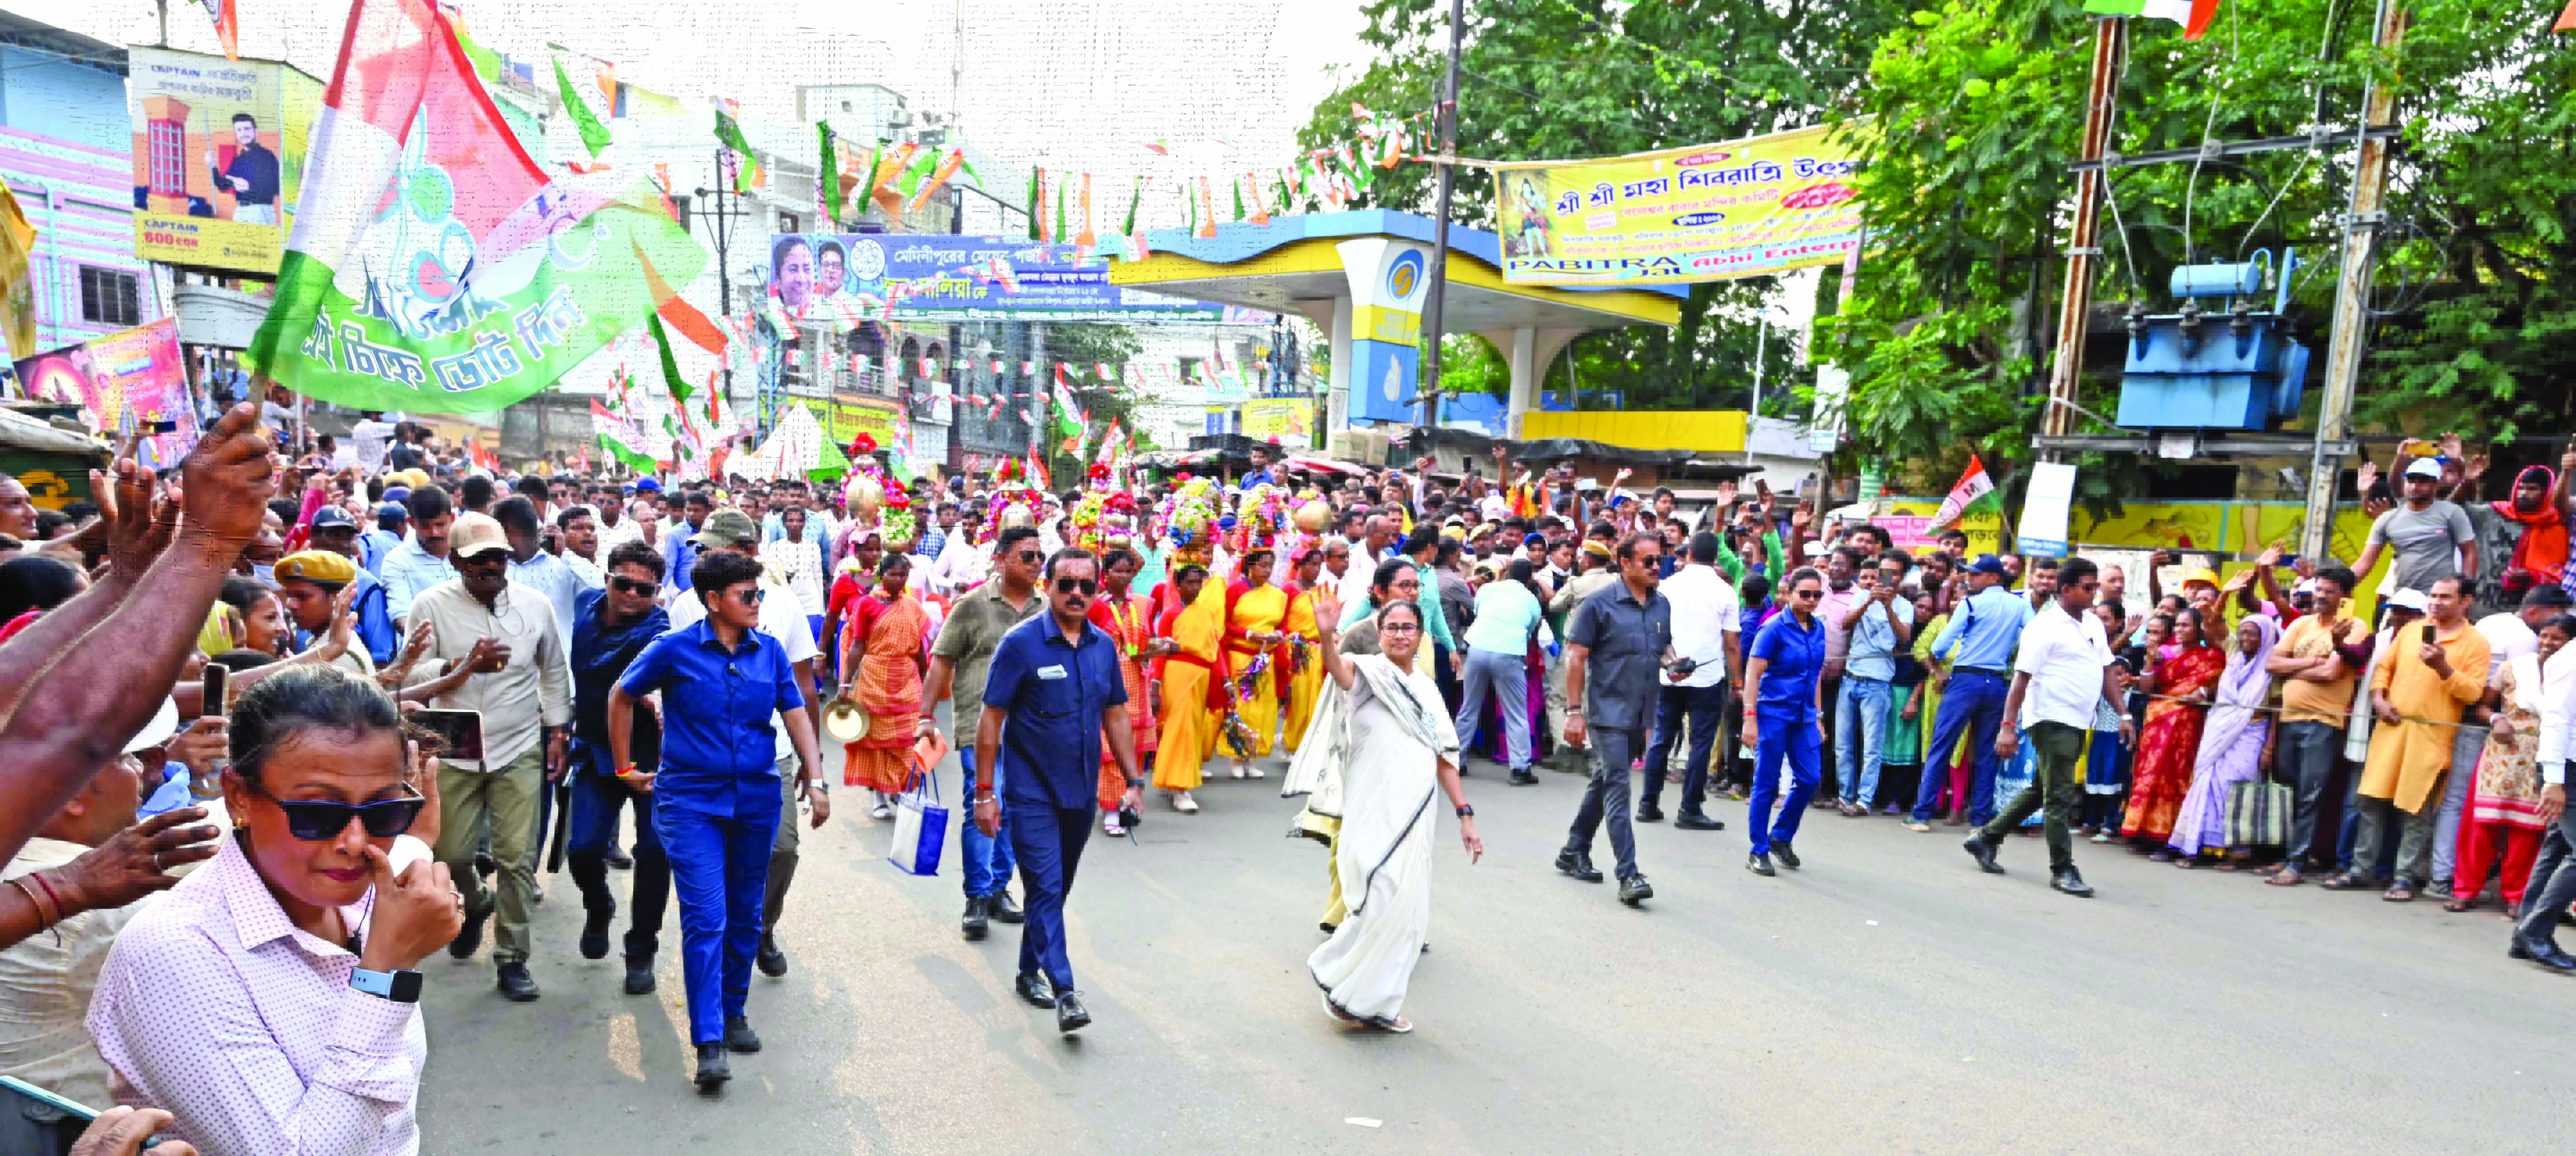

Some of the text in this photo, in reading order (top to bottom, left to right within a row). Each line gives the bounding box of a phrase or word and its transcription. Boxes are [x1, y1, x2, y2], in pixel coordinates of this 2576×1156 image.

[151, 64, 200, 77] CAPTAIN
[1555, 191, 1580, 216] শ্রী
[1588, 182, 1614, 207] শ্রী
[1623, 178, 1669, 198] মহা
[1678, 160, 1784, 190] শিবরাত্রি
[145, 219, 198, 232] CAPTAIN
[145, 231, 174, 245] 600
[894, 245, 966, 266] মেদিনীপুরের
[1693, 252, 1753, 268] Abhi
[1765, 239, 1857, 259] Enterp
[1510, 256, 1679, 270] PABITRA
[429, 330, 523, 392] ভোট
[514, 285, 588, 362] দিন
